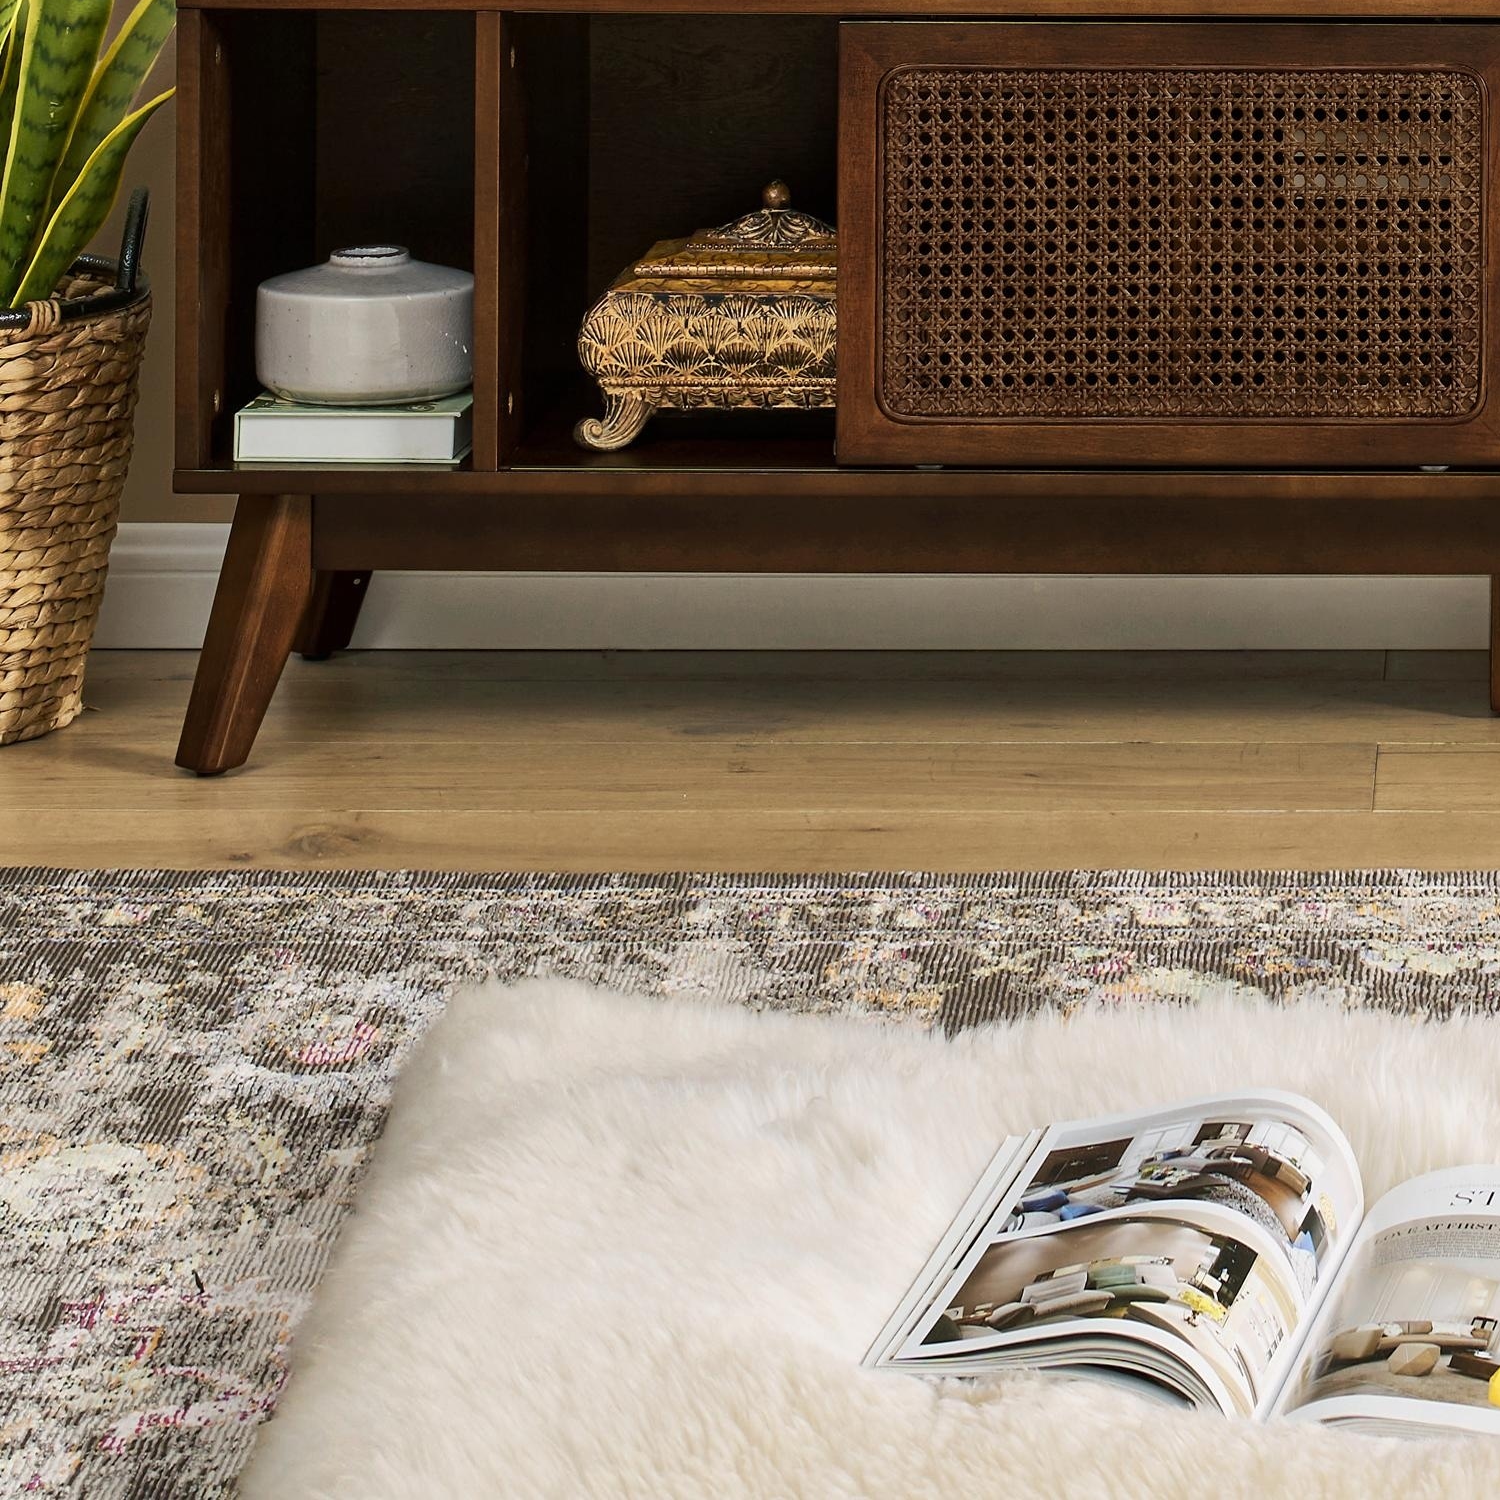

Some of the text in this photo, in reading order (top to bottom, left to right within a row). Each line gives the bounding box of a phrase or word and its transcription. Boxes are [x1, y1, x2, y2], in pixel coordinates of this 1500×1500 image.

[1374, 1226, 1419, 1245] LOVE
[1421, 1222, 1445, 1232] AT
[1446, 1222, 1497, 1231] FIRST
